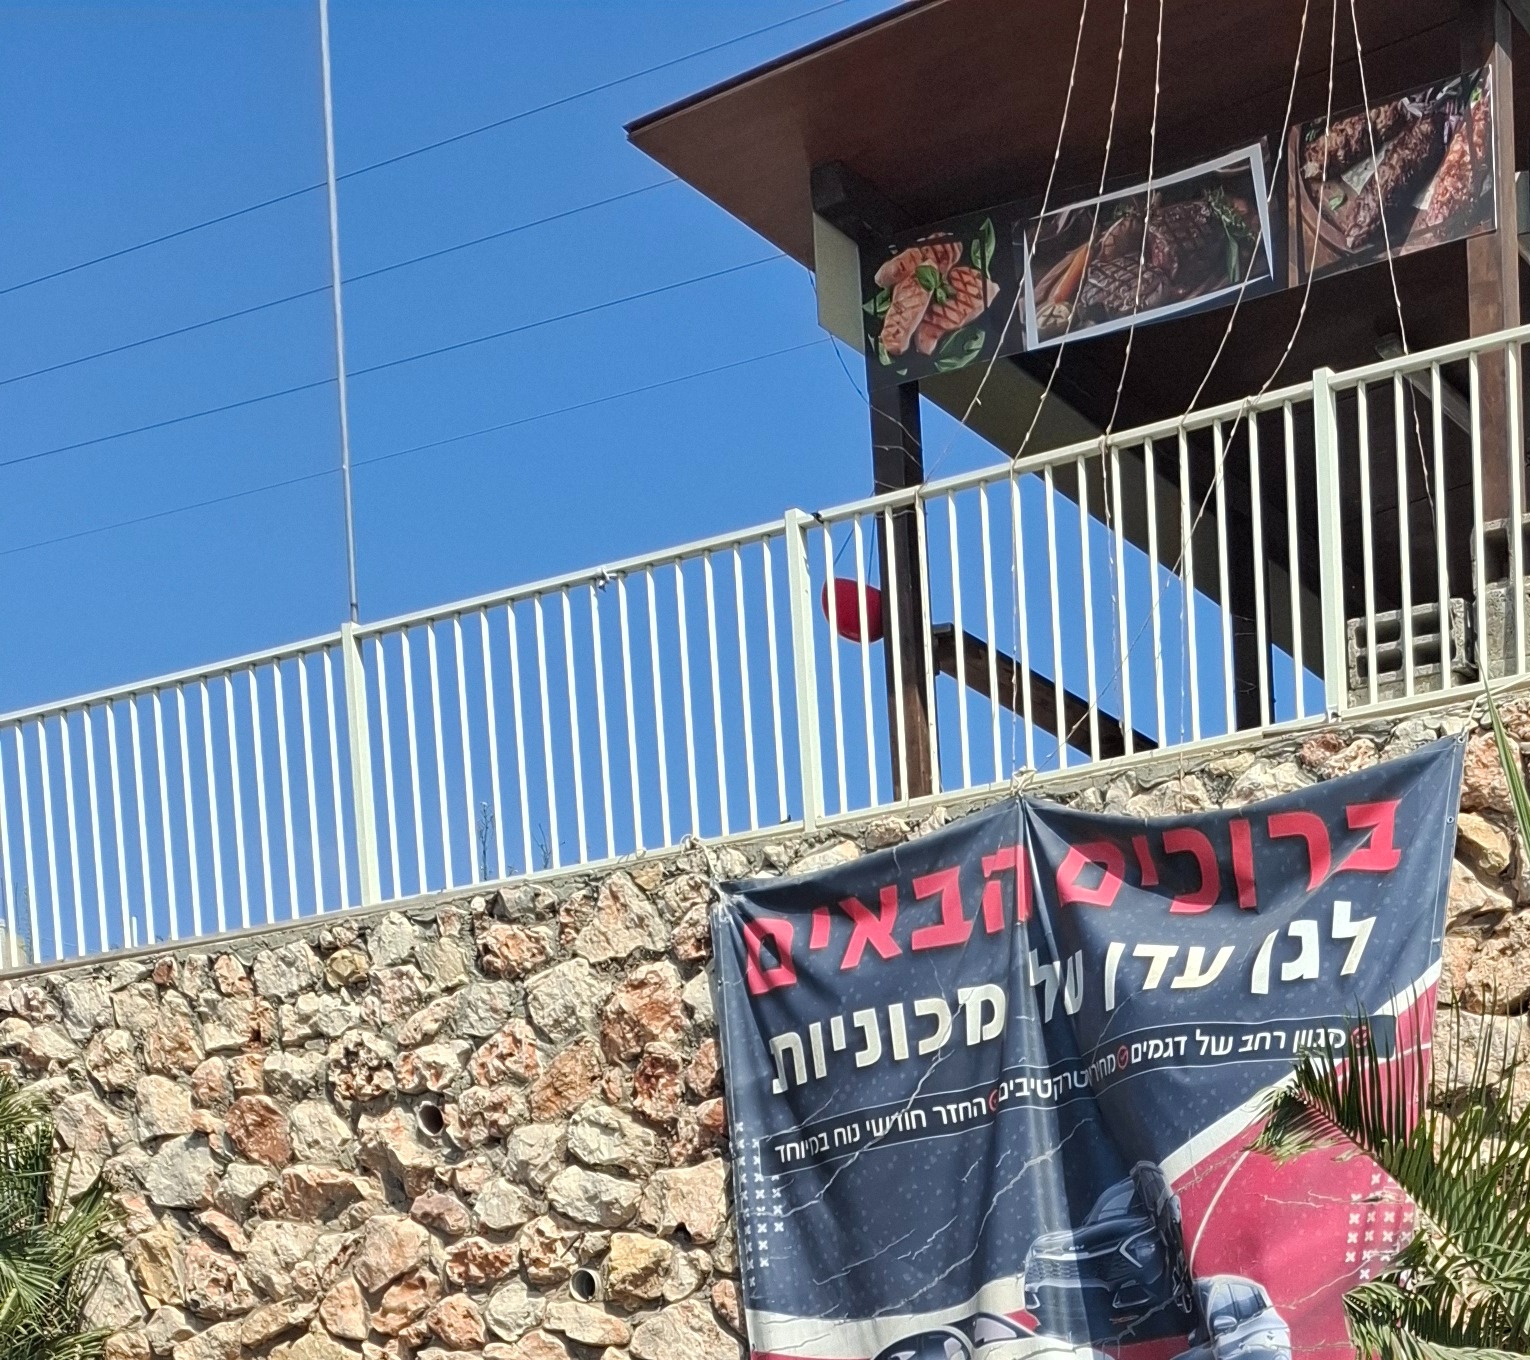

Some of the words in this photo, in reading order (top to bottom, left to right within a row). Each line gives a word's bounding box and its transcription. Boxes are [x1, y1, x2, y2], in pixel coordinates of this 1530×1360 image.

[1056, 798, 1402, 915] ברוכים
[743, 845, 1033, 995] הבאים
[1250, 900, 1377, 995] לגן
[1104, 941, 1236, 1012] עדן
[768, 983, 1007, 1095] מכוניות
[1130, 1036, 1188, 1064] דגמים
[1195, 1029, 1234, 1057] של
[1238, 1031, 1287, 1053] רחב
[865, 1109, 927, 1139] חודשי
[932, 1097, 987, 1125] החזר
[774, 1131, 831, 1163] במיוחד
[833, 1123, 861, 1148] נוח
